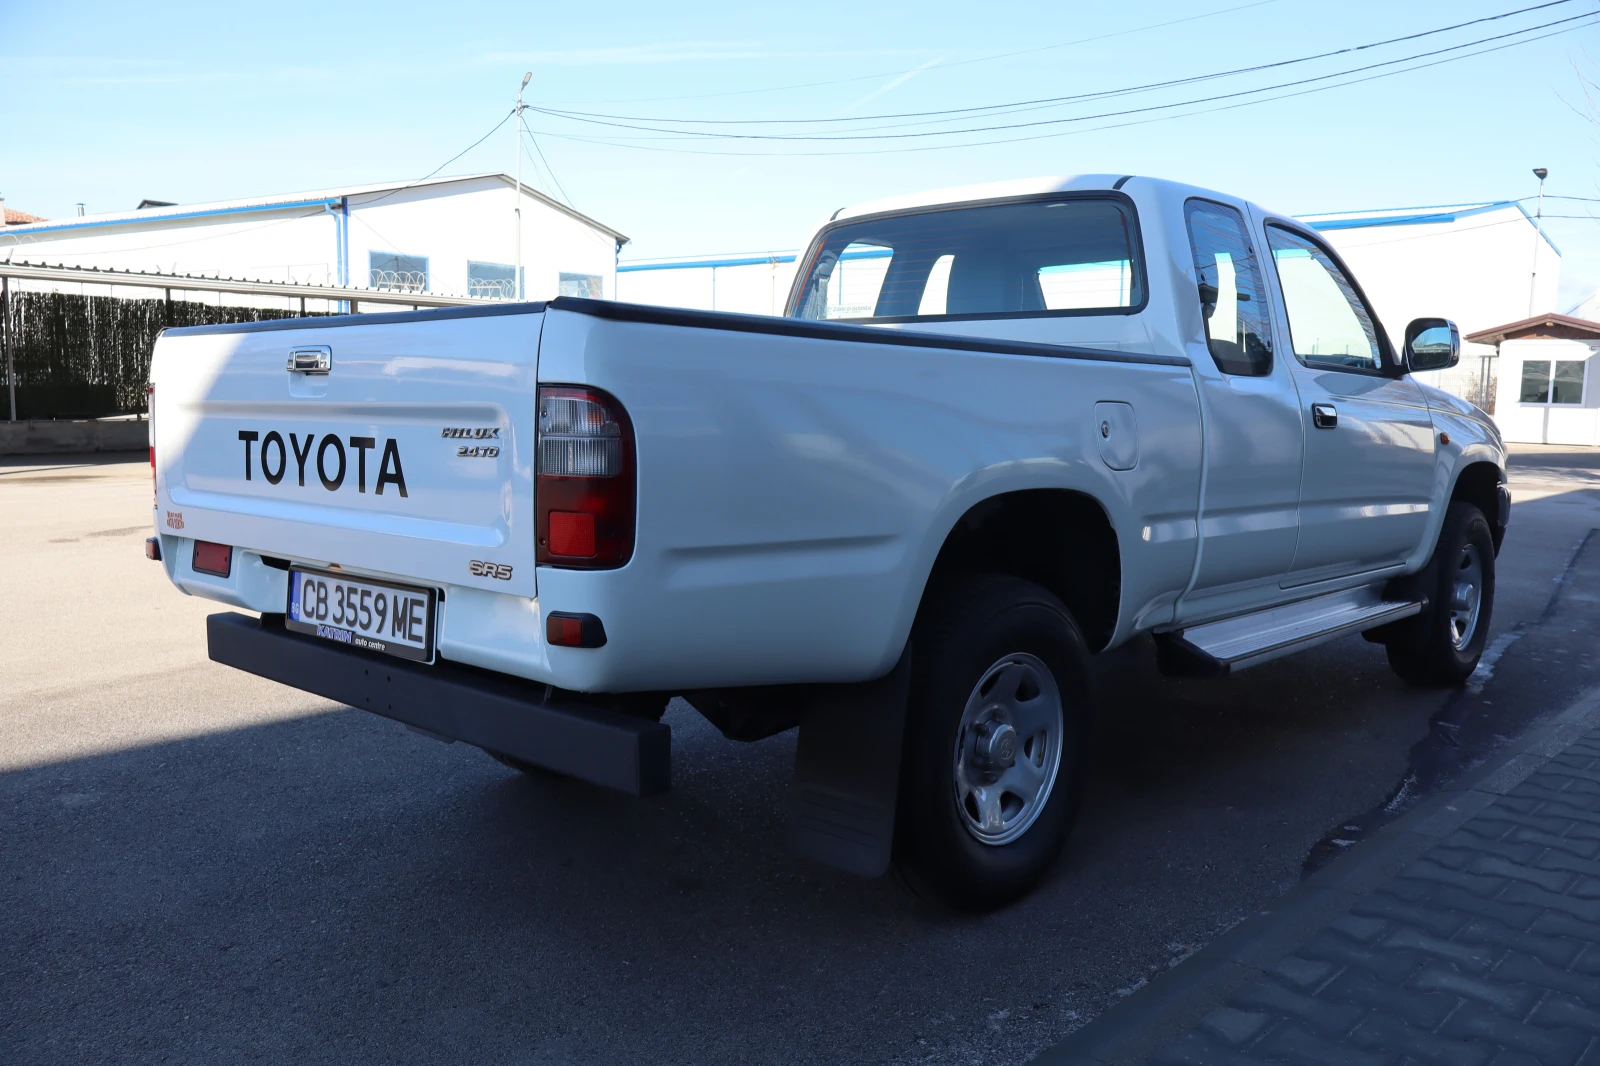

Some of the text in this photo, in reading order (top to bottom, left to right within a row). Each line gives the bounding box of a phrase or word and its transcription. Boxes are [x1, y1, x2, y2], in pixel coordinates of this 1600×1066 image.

[441, 427, 500, 439] HILUX
[238, 430, 409, 498] TOYOTA
[468, 559, 513, 581] SR5
[291, 602, 300, 614] BG
[303, 579, 425, 643] CB 3559 ME
[316, 624, 386, 651] KATRIN auto centre
